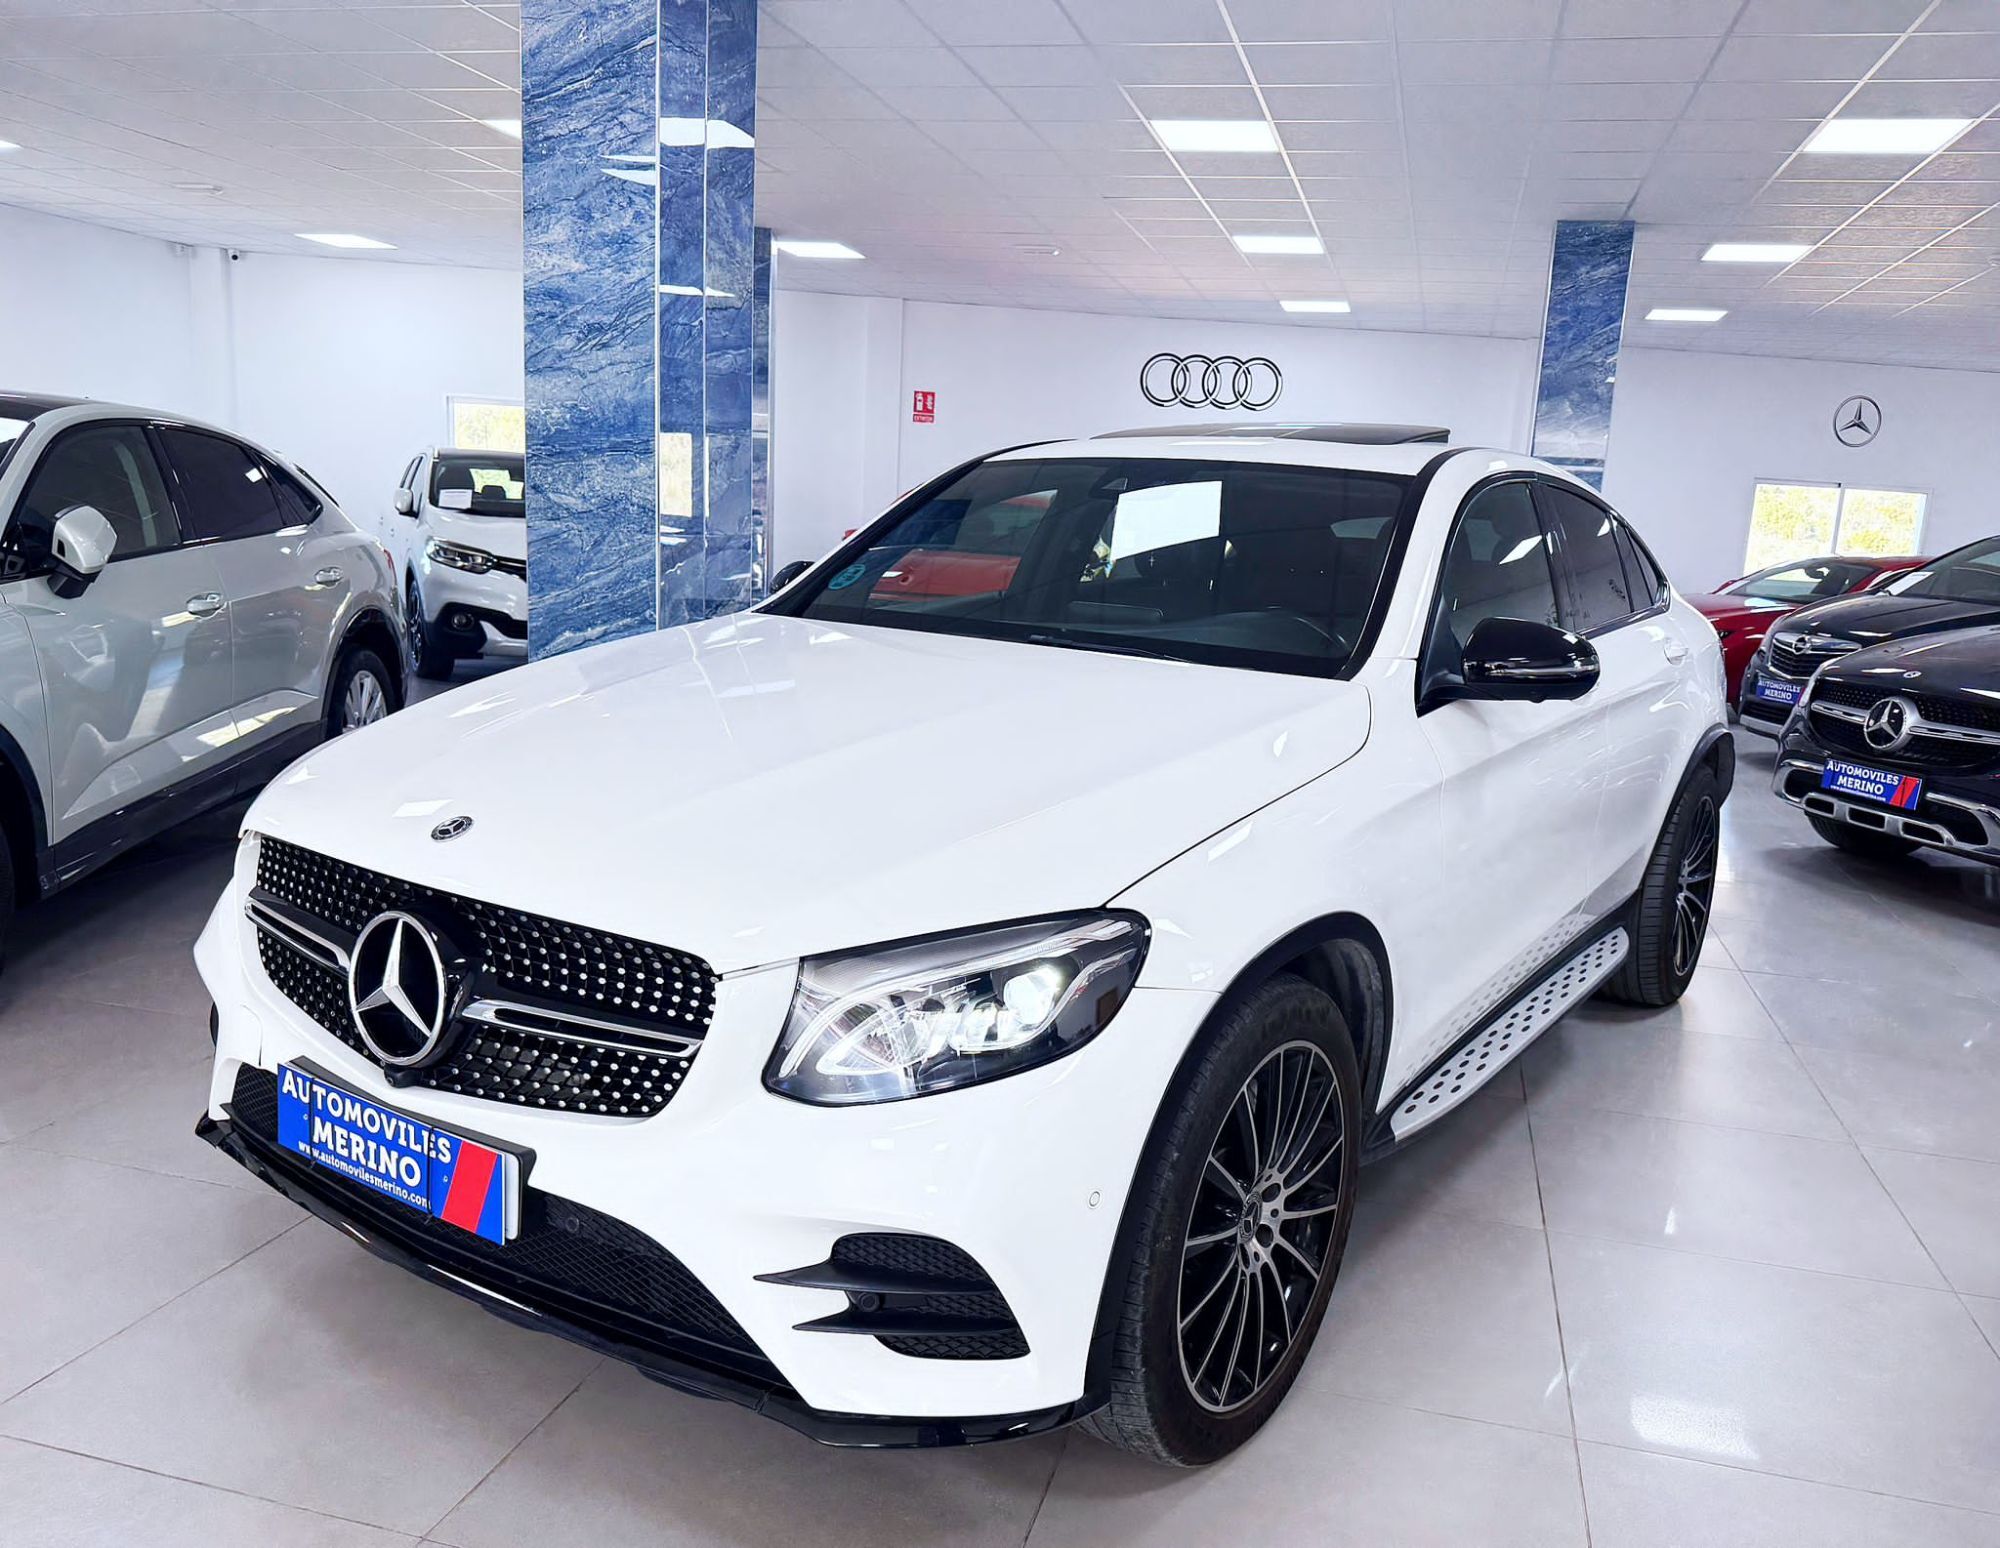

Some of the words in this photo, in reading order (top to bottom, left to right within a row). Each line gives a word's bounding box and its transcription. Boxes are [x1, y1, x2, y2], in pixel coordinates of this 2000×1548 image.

[1826, 760, 1899, 785] AUTOMOVILES
[1837, 775, 1884, 795] MERINO
[281, 1069, 451, 1164] AUTOMOVILES
[312, 1116, 421, 1188] MERINO
